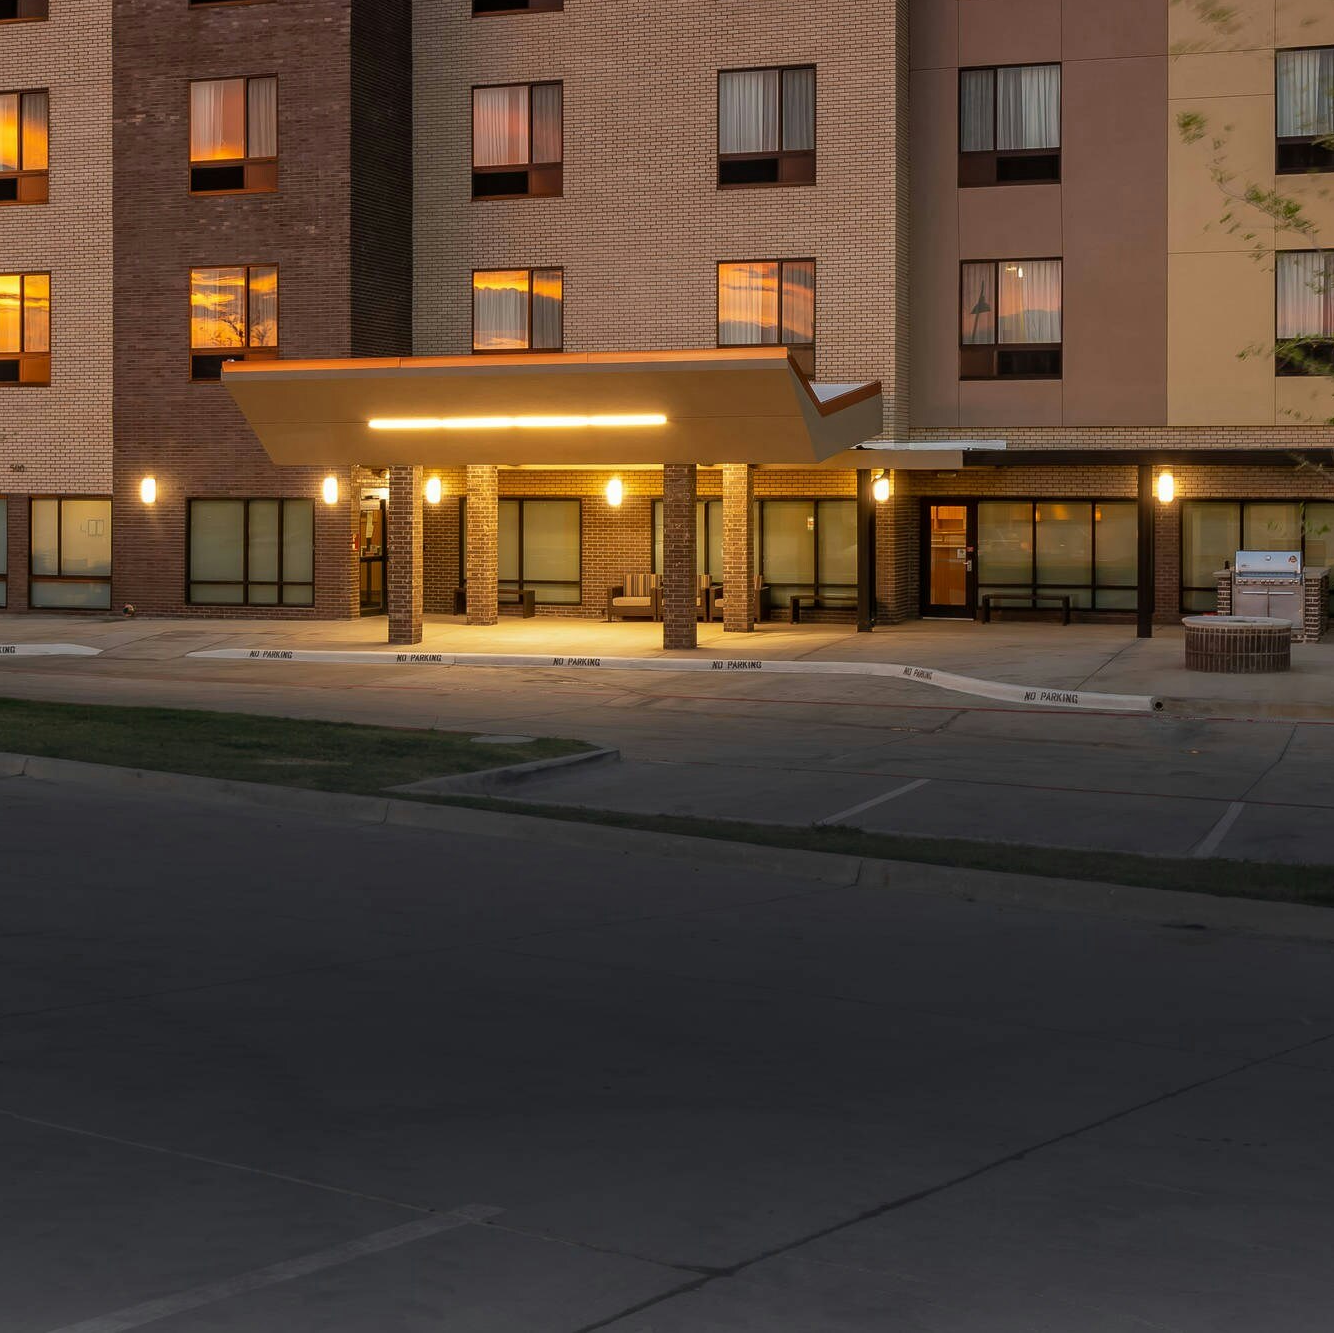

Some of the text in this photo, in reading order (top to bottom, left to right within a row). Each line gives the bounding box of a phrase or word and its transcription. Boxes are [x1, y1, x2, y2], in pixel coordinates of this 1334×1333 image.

[249, 650, 293, 659] NO PARKING
[396, 654, 442, 662] NO PARKING
[553, 658, 601, 667] NO PARKING
[712, 661, 762, 669] NO PARKING
[1024, 691, 1078, 704] NO PARKING
